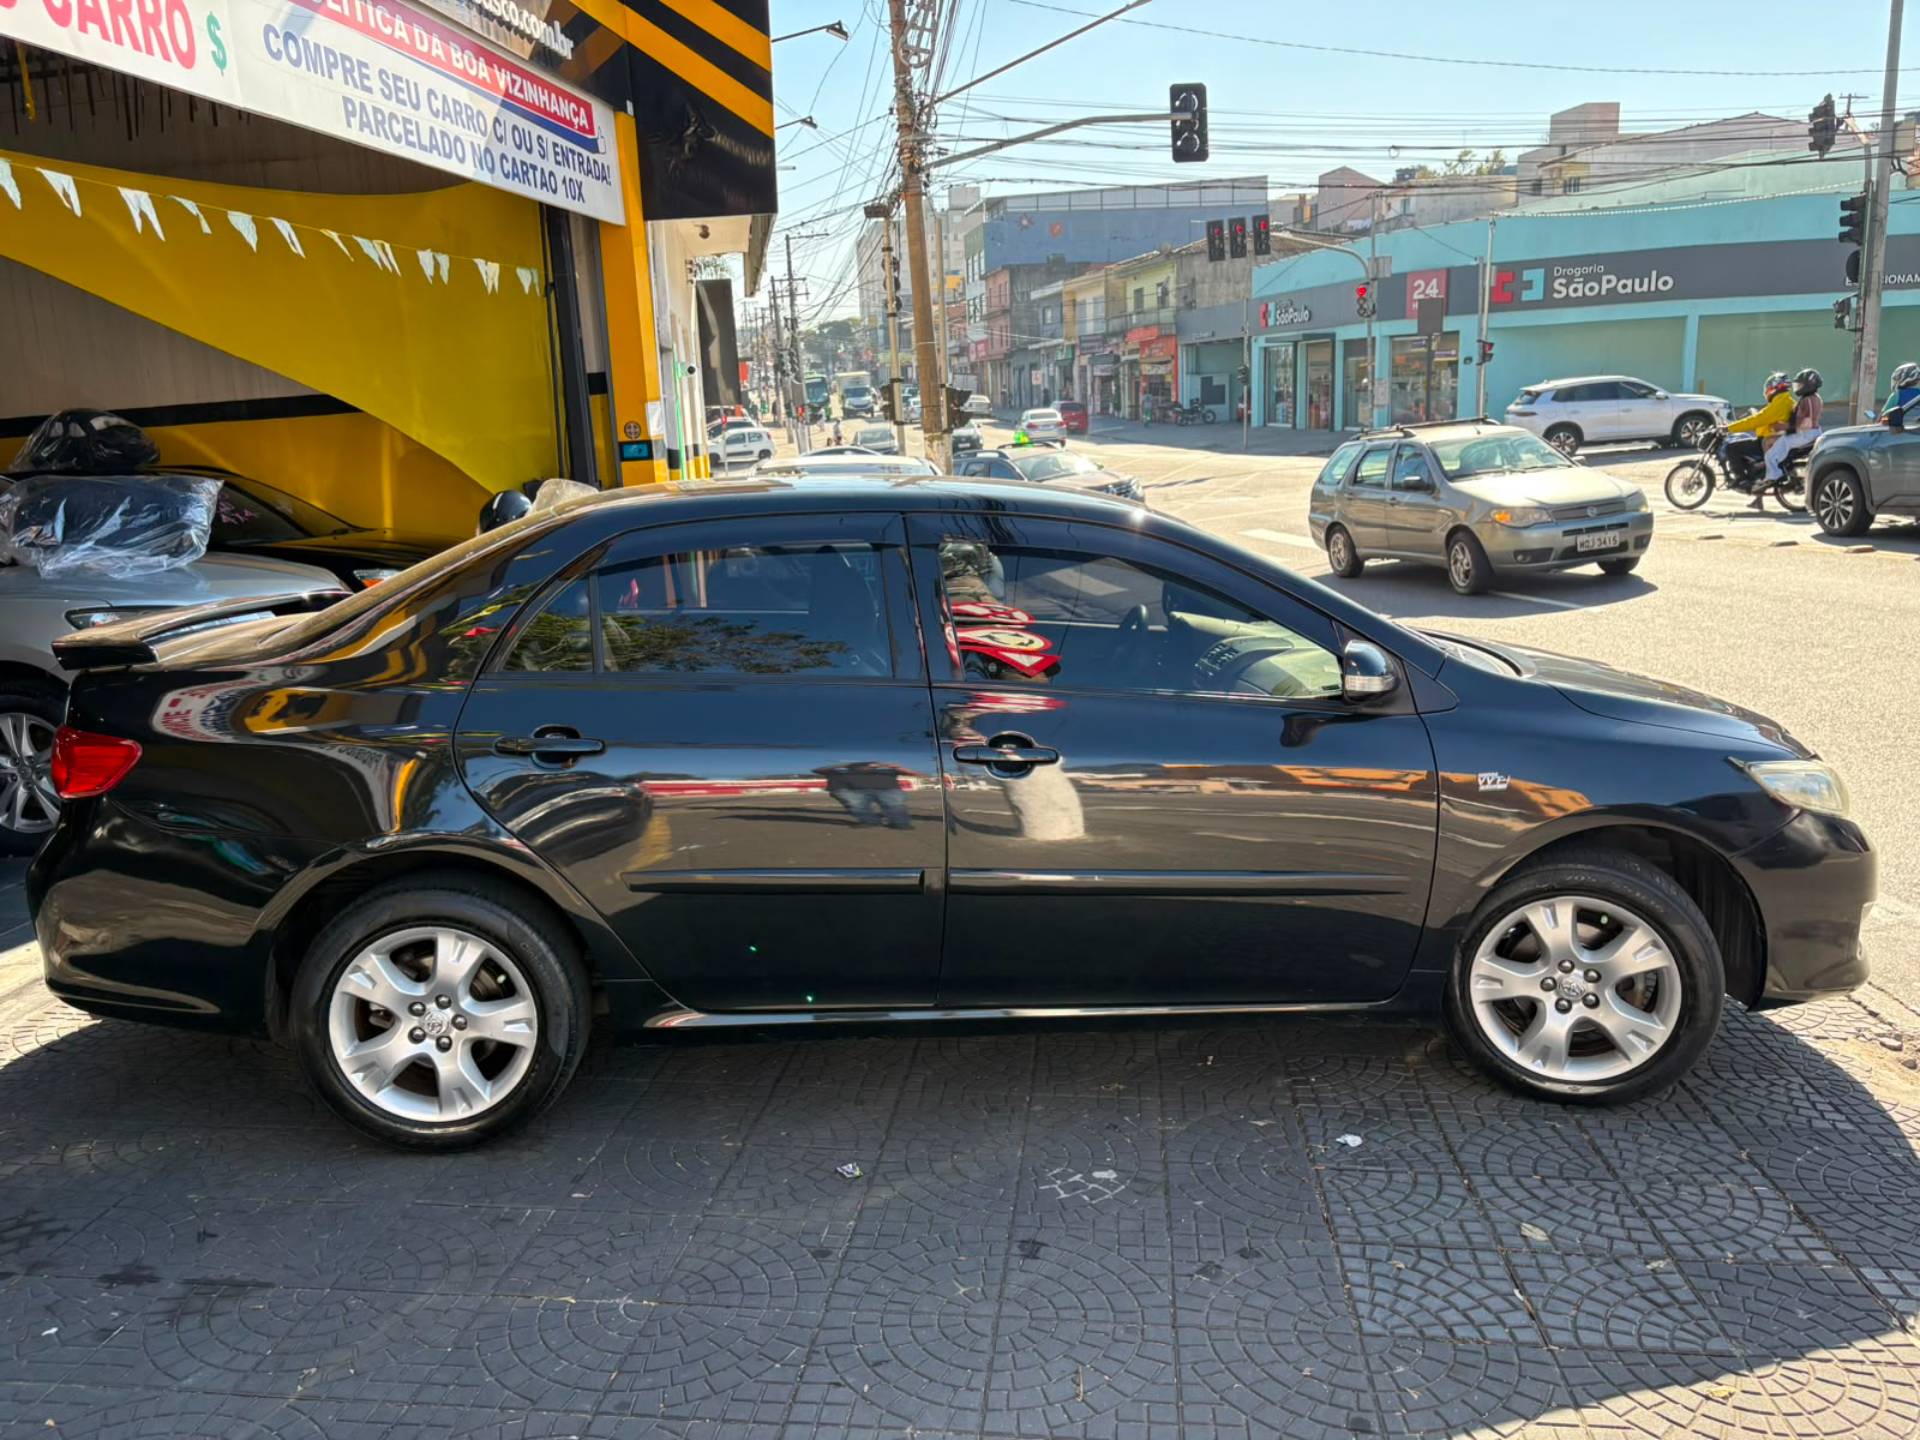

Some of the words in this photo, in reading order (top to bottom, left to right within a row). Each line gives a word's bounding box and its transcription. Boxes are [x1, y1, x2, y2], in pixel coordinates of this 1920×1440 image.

[206, 11, 228, 77] $
[412, 23, 448, 63] DA
[448, 40, 492, 85] BOA
[493, 62, 590, 131] VIZINHANÇA
[263, 23, 375, 96] COMPRE
[377, 67, 421, 112] SEU
[426, 88, 488, 139] CARRO
[511, 123, 534, 155] OU
[551, 141, 613, 187] ENTRADA!
[342, 95, 467, 164] PARCELADO
[470, 141, 495, 176] NO
[561, 175, 586, 204] 10X
[1412, 277, 1440, 300] 24
[1553, 264, 1604, 277] Drogaria
